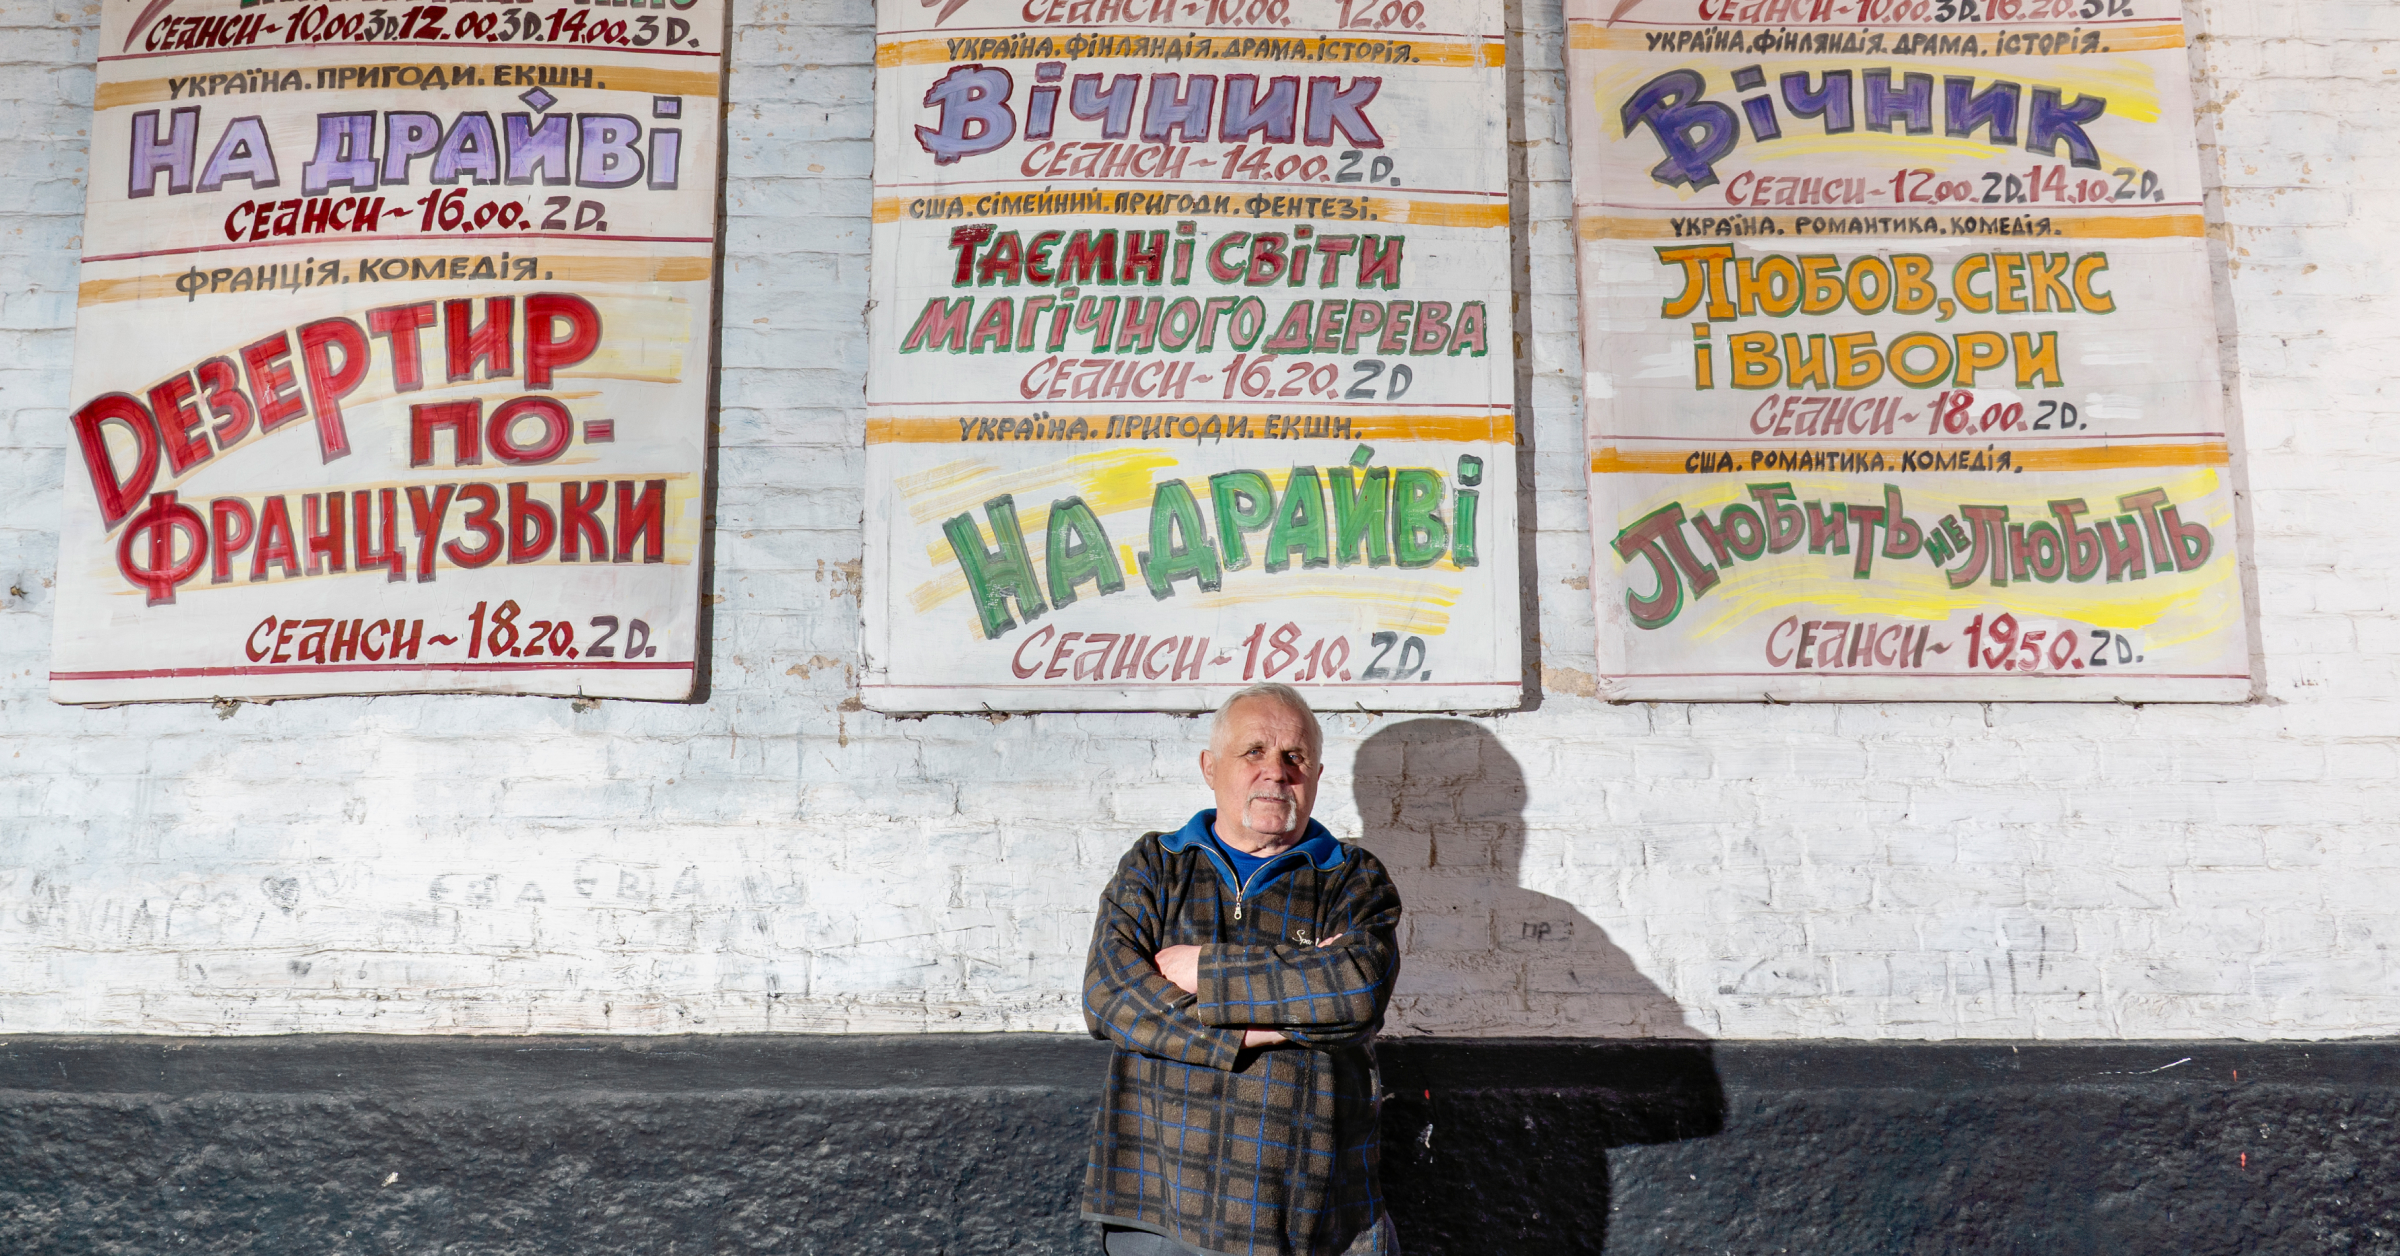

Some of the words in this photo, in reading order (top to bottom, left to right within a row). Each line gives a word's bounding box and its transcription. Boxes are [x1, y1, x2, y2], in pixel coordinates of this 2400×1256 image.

[127, 104, 281, 198] НА
[1952, 250, 2117, 315] СЕКС
[1262, 298, 1489, 357] ДЕРЕВА
[1727, 330, 2064, 391] ВИБОРИ
[409, 395, 615, 469] ПО-
[115, 479, 667, 608] ФРАНЦУЗЬКИ
[942, 494, 1125, 640] НА
[1610, 482, 1924, 631] ЛЮБИТЬ
[1923, 513, 1972, 569] НЕ
[1945, 486, 2214, 590] ЛЮБИТЬ
